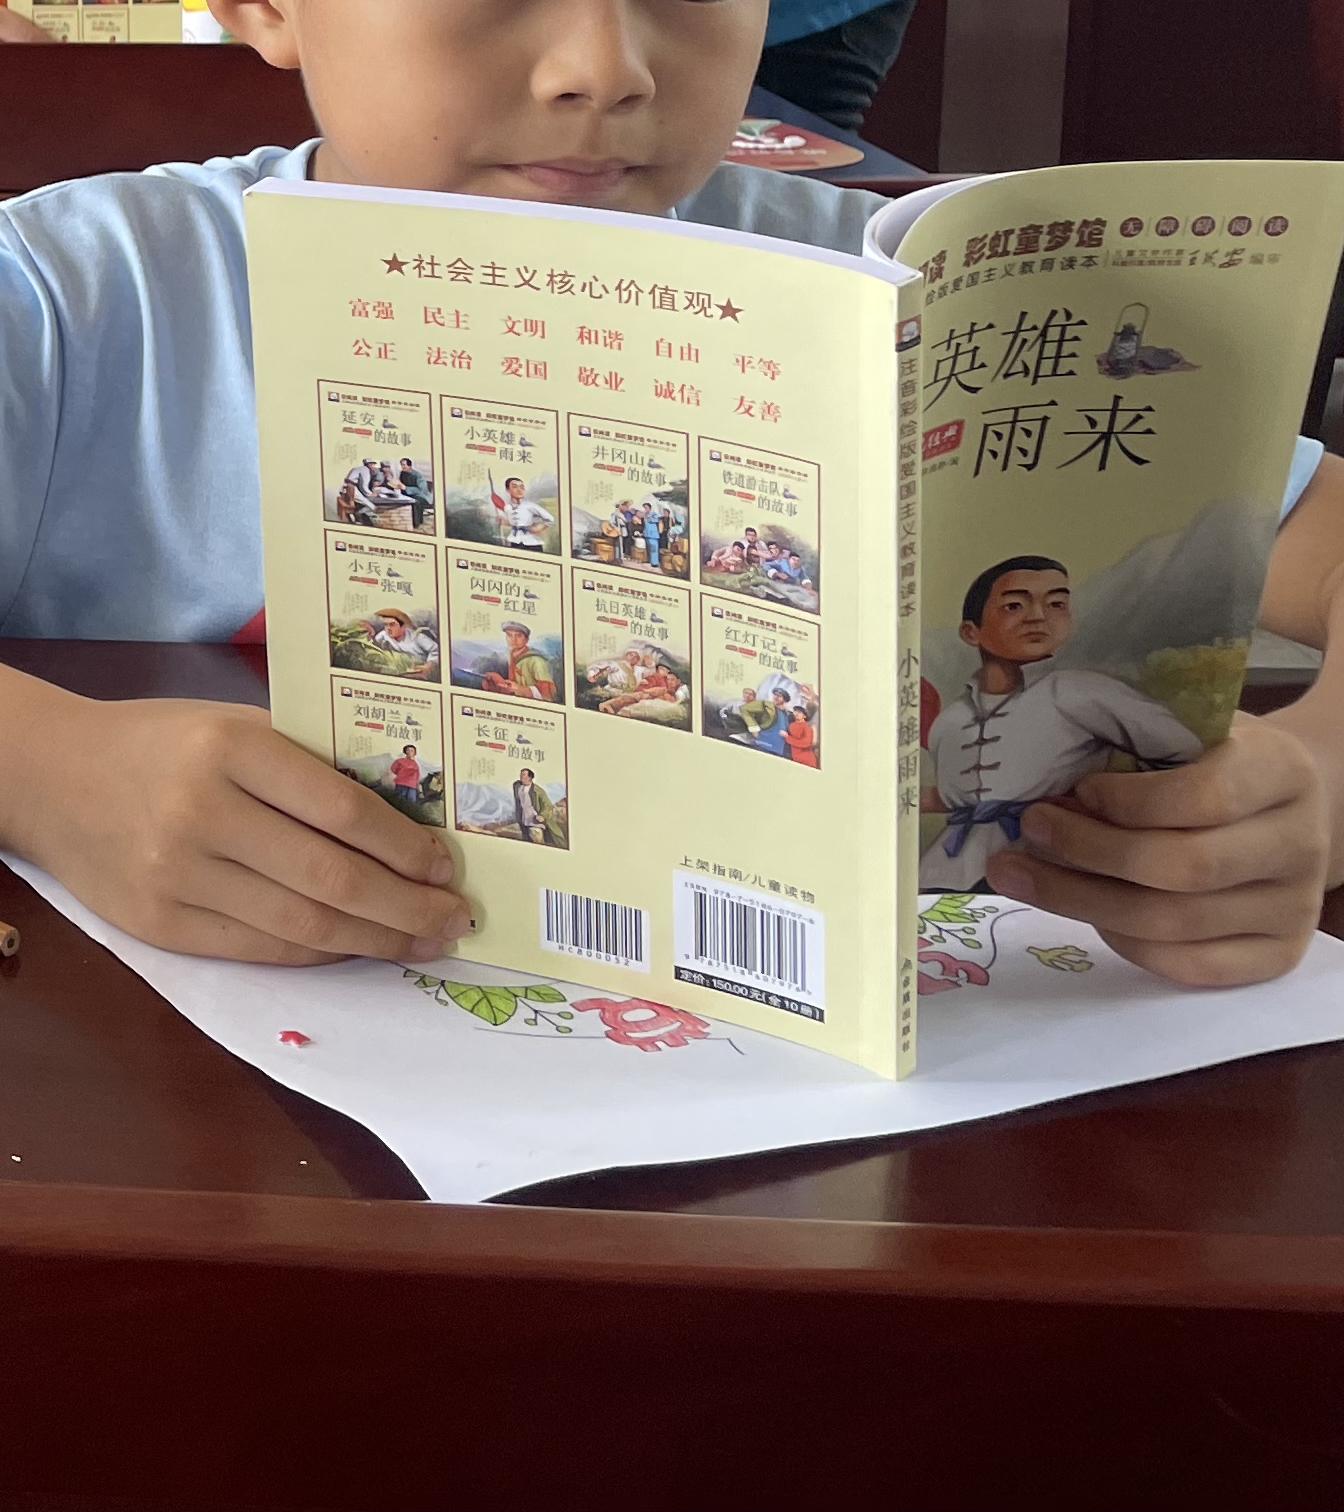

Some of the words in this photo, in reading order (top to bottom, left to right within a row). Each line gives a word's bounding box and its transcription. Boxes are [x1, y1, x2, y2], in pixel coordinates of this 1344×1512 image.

[963, 217, 1108, 268] 彩虹童梦馆
[411, 253, 715, 320] 社会主义核心价值观
[347, 298, 396, 323] 富强
[423, 306, 471, 332] 民主
[499, 315, 547, 341] 文明
[575, 325, 625, 352] 和谐
[654, 336, 701, 366] 自由
[732, 352, 783, 382] 平等
[923, 306, 1089, 413] 英雄
[350, 337, 398, 363] 公正
[426, 346, 474, 370] 法治
[500, 356, 549, 381] 爱国
[577, 366, 627, 394] 敬业
[652, 378, 702, 408] 诚信
[732, 394, 783, 424] 友善
[341, 410, 375, 427] 延安
[374, 428, 412, 447] 的故事
[464, 426, 516, 445] 小英雄
[972, 393, 1158, 480] 雨来
[499, 447, 534, 464] 雨来
[592, 444, 645, 467] 井冈山
[627, 467, 667, 487] 的故事
[757, 495, 798, 517] 的故事
[348, 558, 382, 576] 小兵
[470, 576, 521, 598] 闪闪的
[503, 598, 538, 616] 红星
[595, 597, 647, 620] 抗日英雄
[630, 620, 669, 641] 的故事
[724, 626, 778, 653] 红灯记
[758, 653, 798, 675] 的故事
[353, 704, 404, 724] 刘胡兰
[385, 723, 423, 742] 的故事
[474, 724, 510, 741] 长征
[896, 646, 920, 817] 小英雄雨来
[507, 743, 546, 763] 的故事
